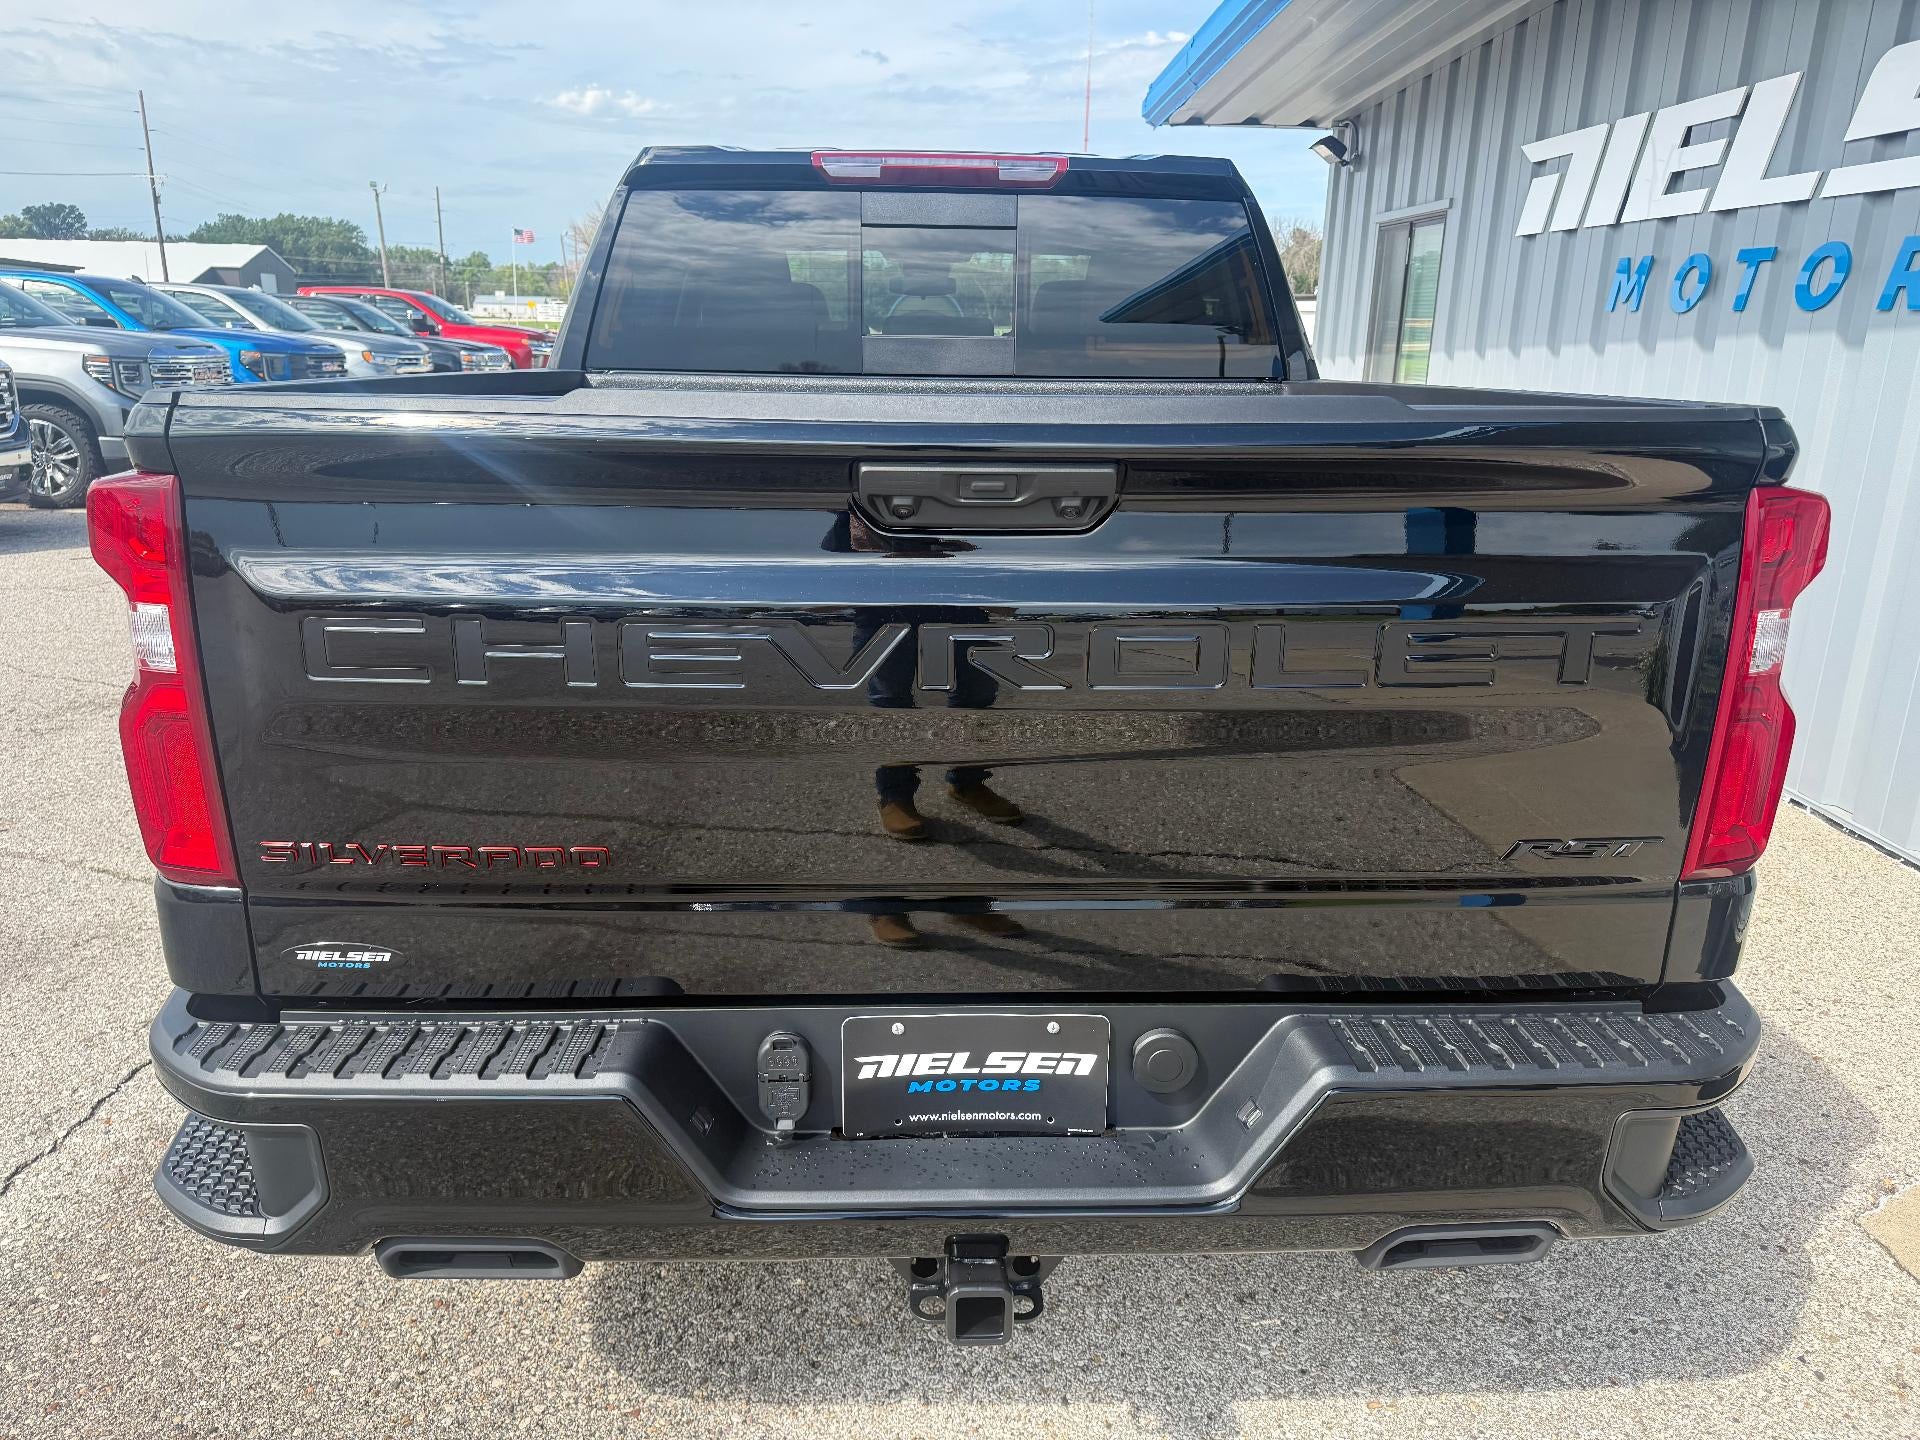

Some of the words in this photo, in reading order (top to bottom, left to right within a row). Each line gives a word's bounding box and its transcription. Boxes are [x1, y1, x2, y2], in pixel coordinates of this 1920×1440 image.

[301, 615, 1643, 692] CHEVROLET
[259, 841, 612, 870] SILVERADO
[1500, 836, 1665, 861] RST
[294, 950, 392, 962] NIELSEN
[317, 961, 371, 969] MOTORS
[853, 1051, 1098, 1080] NIELSEN
[908, 1079, 1041, 1094] MOTORS
[908, 1109, 1042, 1122] www.nielsenmotors.com
